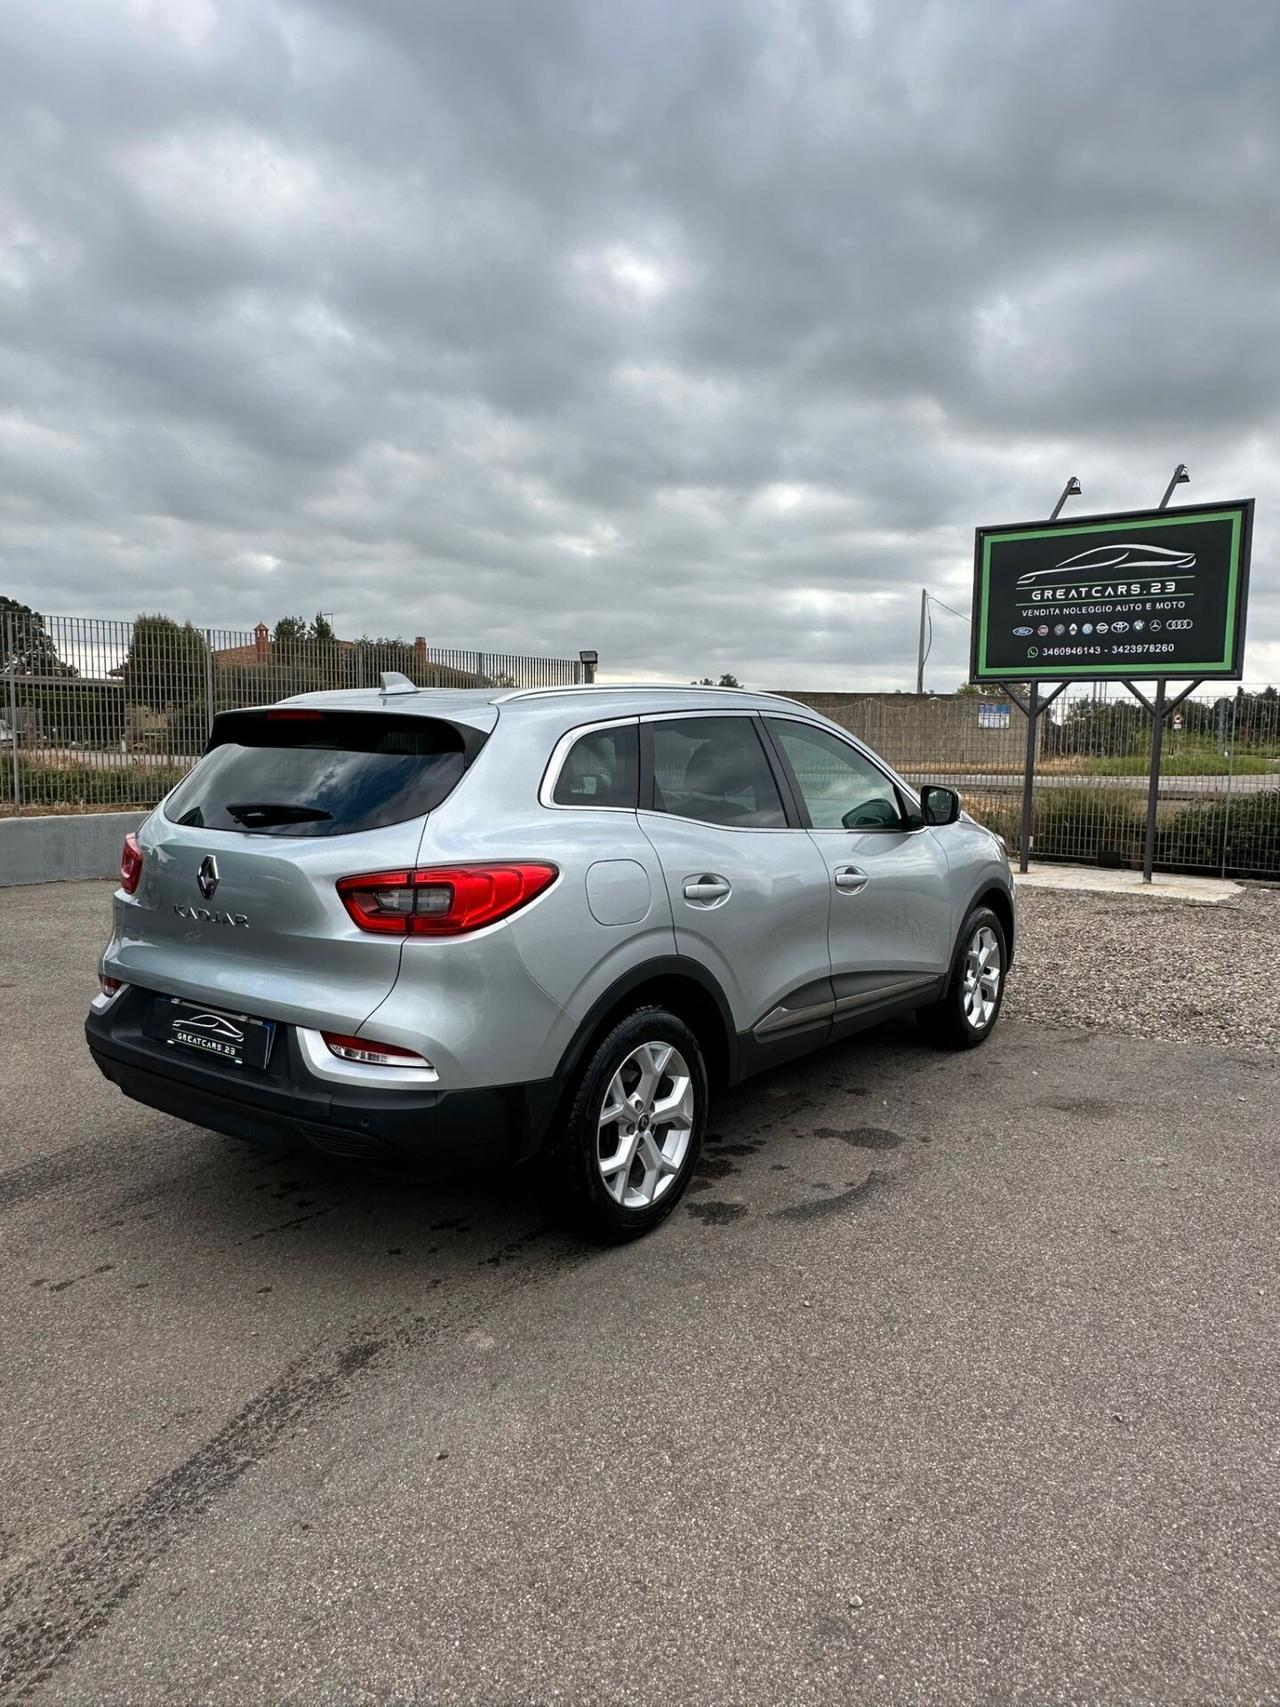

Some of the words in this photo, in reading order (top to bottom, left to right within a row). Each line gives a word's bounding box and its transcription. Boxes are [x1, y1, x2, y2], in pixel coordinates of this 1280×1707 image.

[1022, 608, 1061, 617] VENDITA
[1062, 604, 1113, 615] NOLEGGIO
[1115, 603, 1142, 612] AUTO
[1145, 602, 1152, 610] E
[1155, 601, 1186, 610] MOTO
[1042, 645, 1101, 656] 3460946143
[1111, 643, 1175, 654] 3423978260
[173, 904, 249, 928] KADJAR
